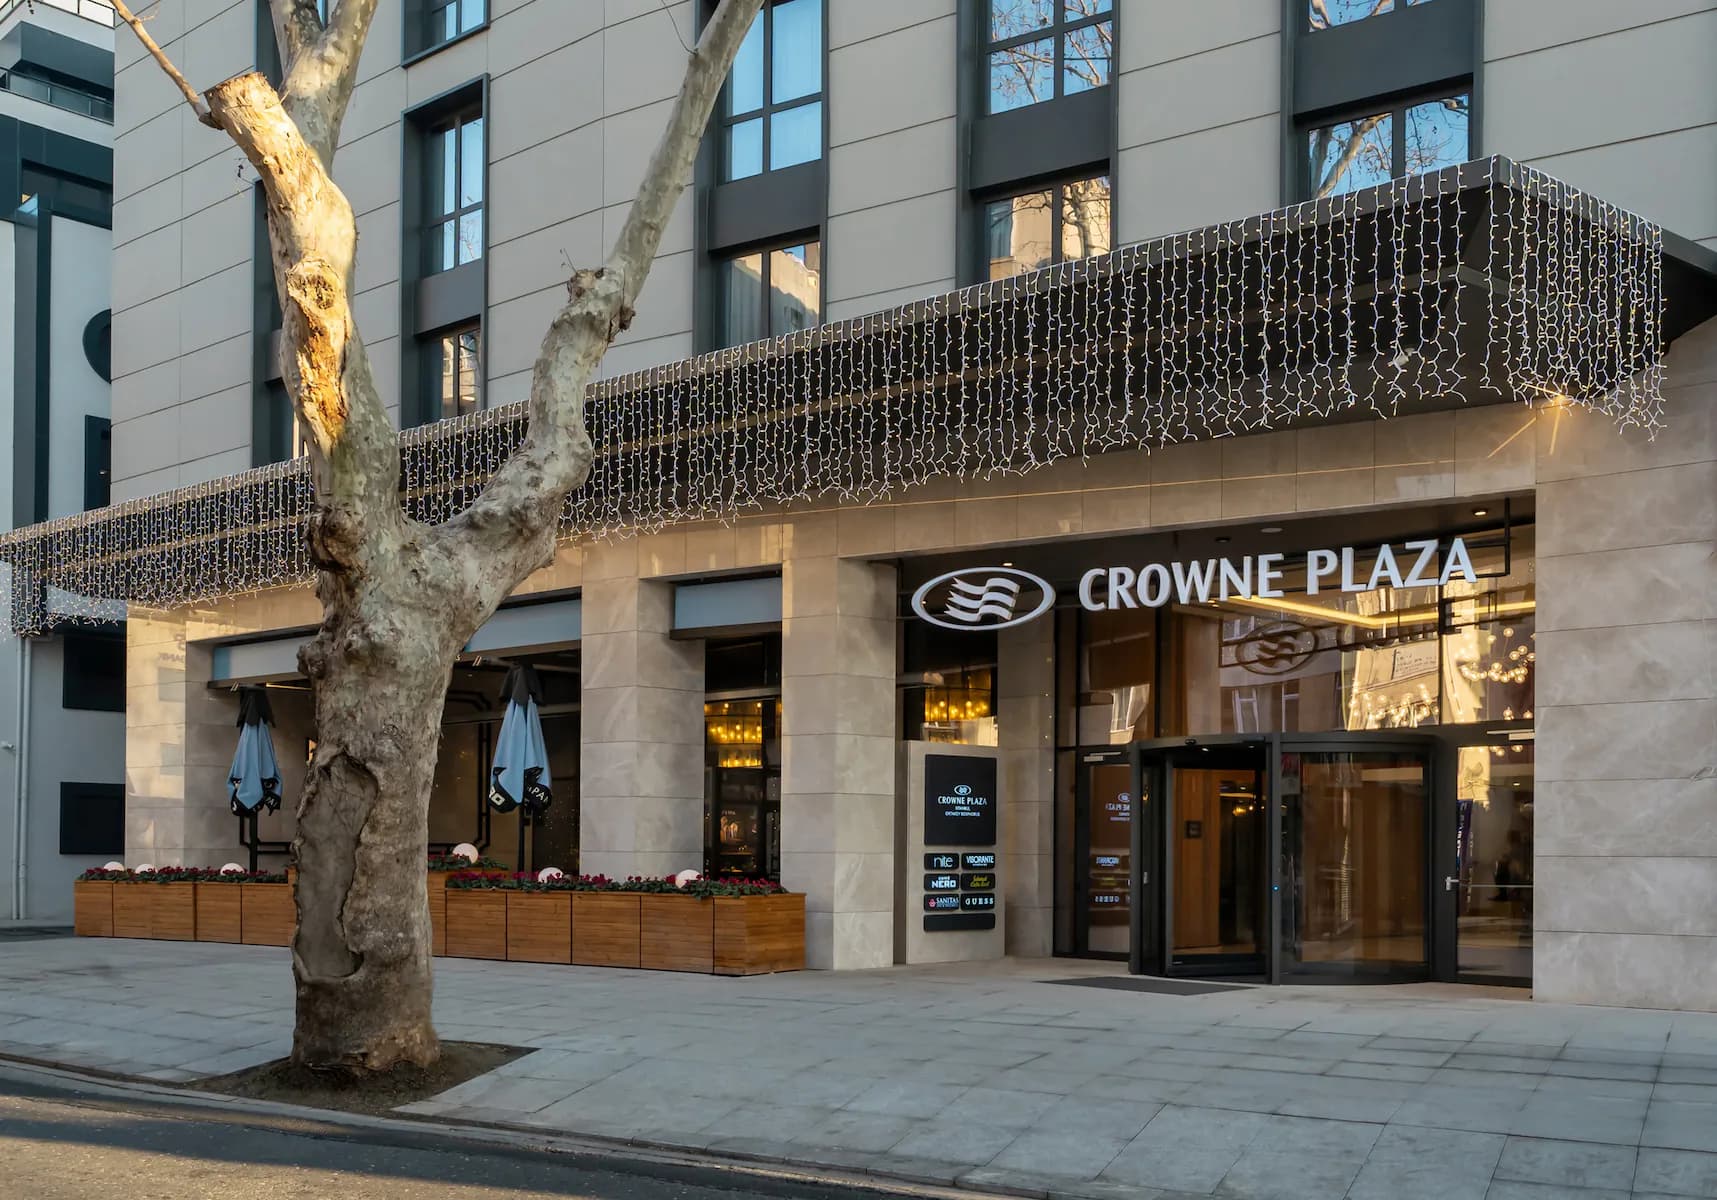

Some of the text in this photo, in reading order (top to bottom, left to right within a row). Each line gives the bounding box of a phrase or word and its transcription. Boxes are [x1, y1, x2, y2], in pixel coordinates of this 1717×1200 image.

[1078, 538, 1478, 612] CROWNE PLAZA
[938, 796, 988, 805] CROWNE PLAZA
[933, 855, 954, 868] nite
[931, 879, 957, 889] NERO
[965, 897, 994, 906] GUESS
